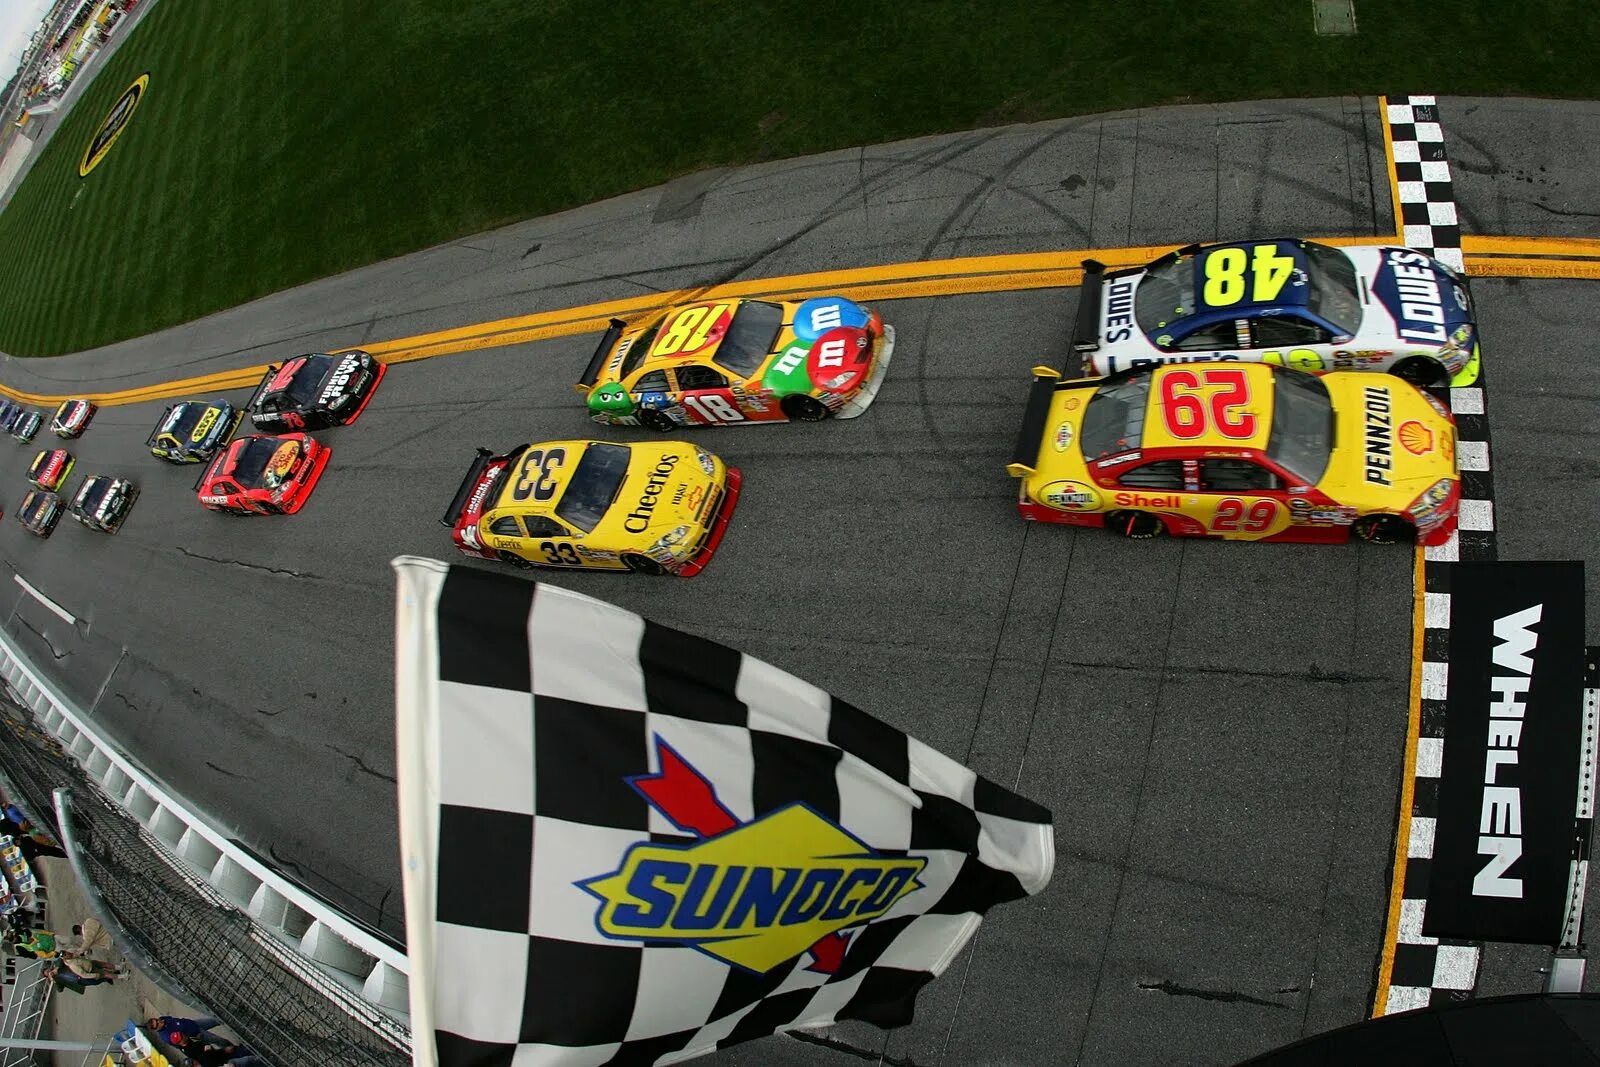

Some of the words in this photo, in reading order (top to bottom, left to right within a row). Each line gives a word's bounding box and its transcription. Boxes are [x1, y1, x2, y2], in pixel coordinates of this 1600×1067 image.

[1203, 244, 1297, 307] 48
[1387, 251, 1448, 342] LOWE'S
[652, 304, 730, 357] 18
[818, 339, 845, 367] m
[318, 353, 356, 405] FURNITURE
[331, 358, 361, 397] ROW
[1160, 369, 1259, 439] 29
[681, 395, 745, 422] 18
[1363, 386, 1392, 486] PENNZOIL
[95, 479, 122, 519] ARMY
[513, 447, 567, 501] 33
[624, 454, 680, 534] Cheerios
[1114, 493, 1181, 508] Shell
[1210, 498, 1280, 533] 29
[539, 540, 582, 566] 33
[1472, 603, 1543, 899] WHELEN
[610, 858, 919, 929] SUNOCO
